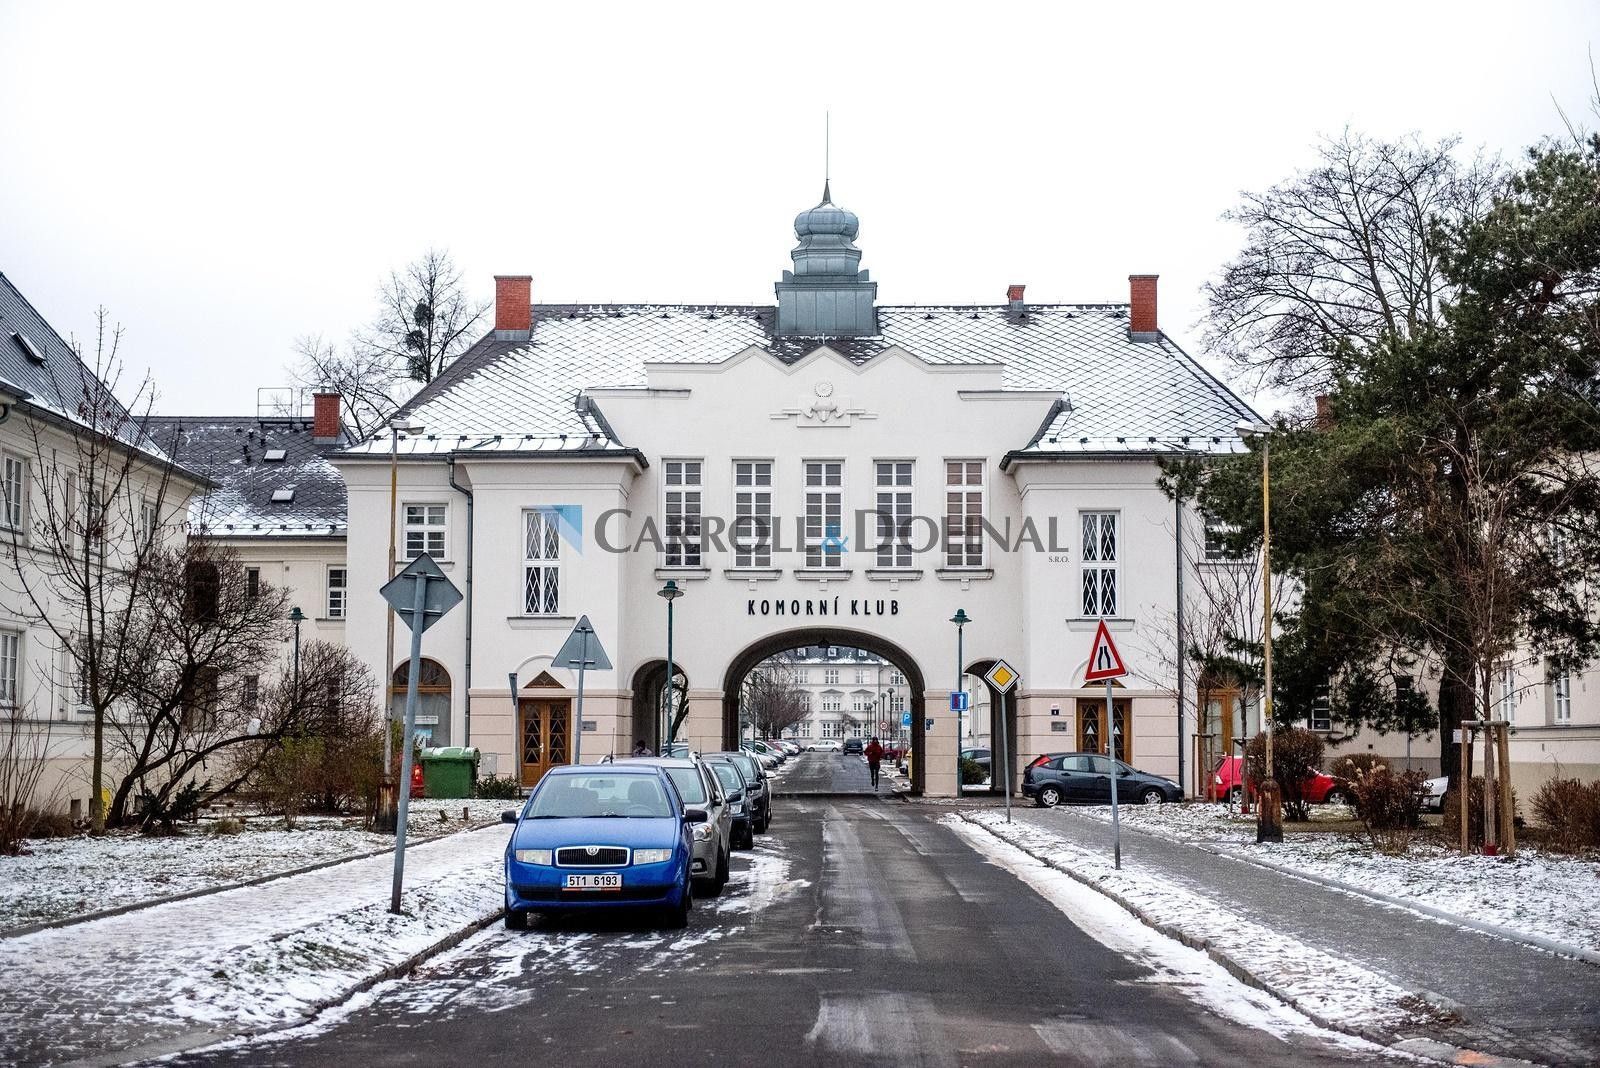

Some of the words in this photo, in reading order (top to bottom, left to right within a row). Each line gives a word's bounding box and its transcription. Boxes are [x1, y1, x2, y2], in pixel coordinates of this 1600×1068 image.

[747, 595, 839, 616] KOMORNÍ
[851, 599, 899, 616] KLUB
[569, 876, 587, 886] 5T1
[593, 876, 618, 886] 6193
